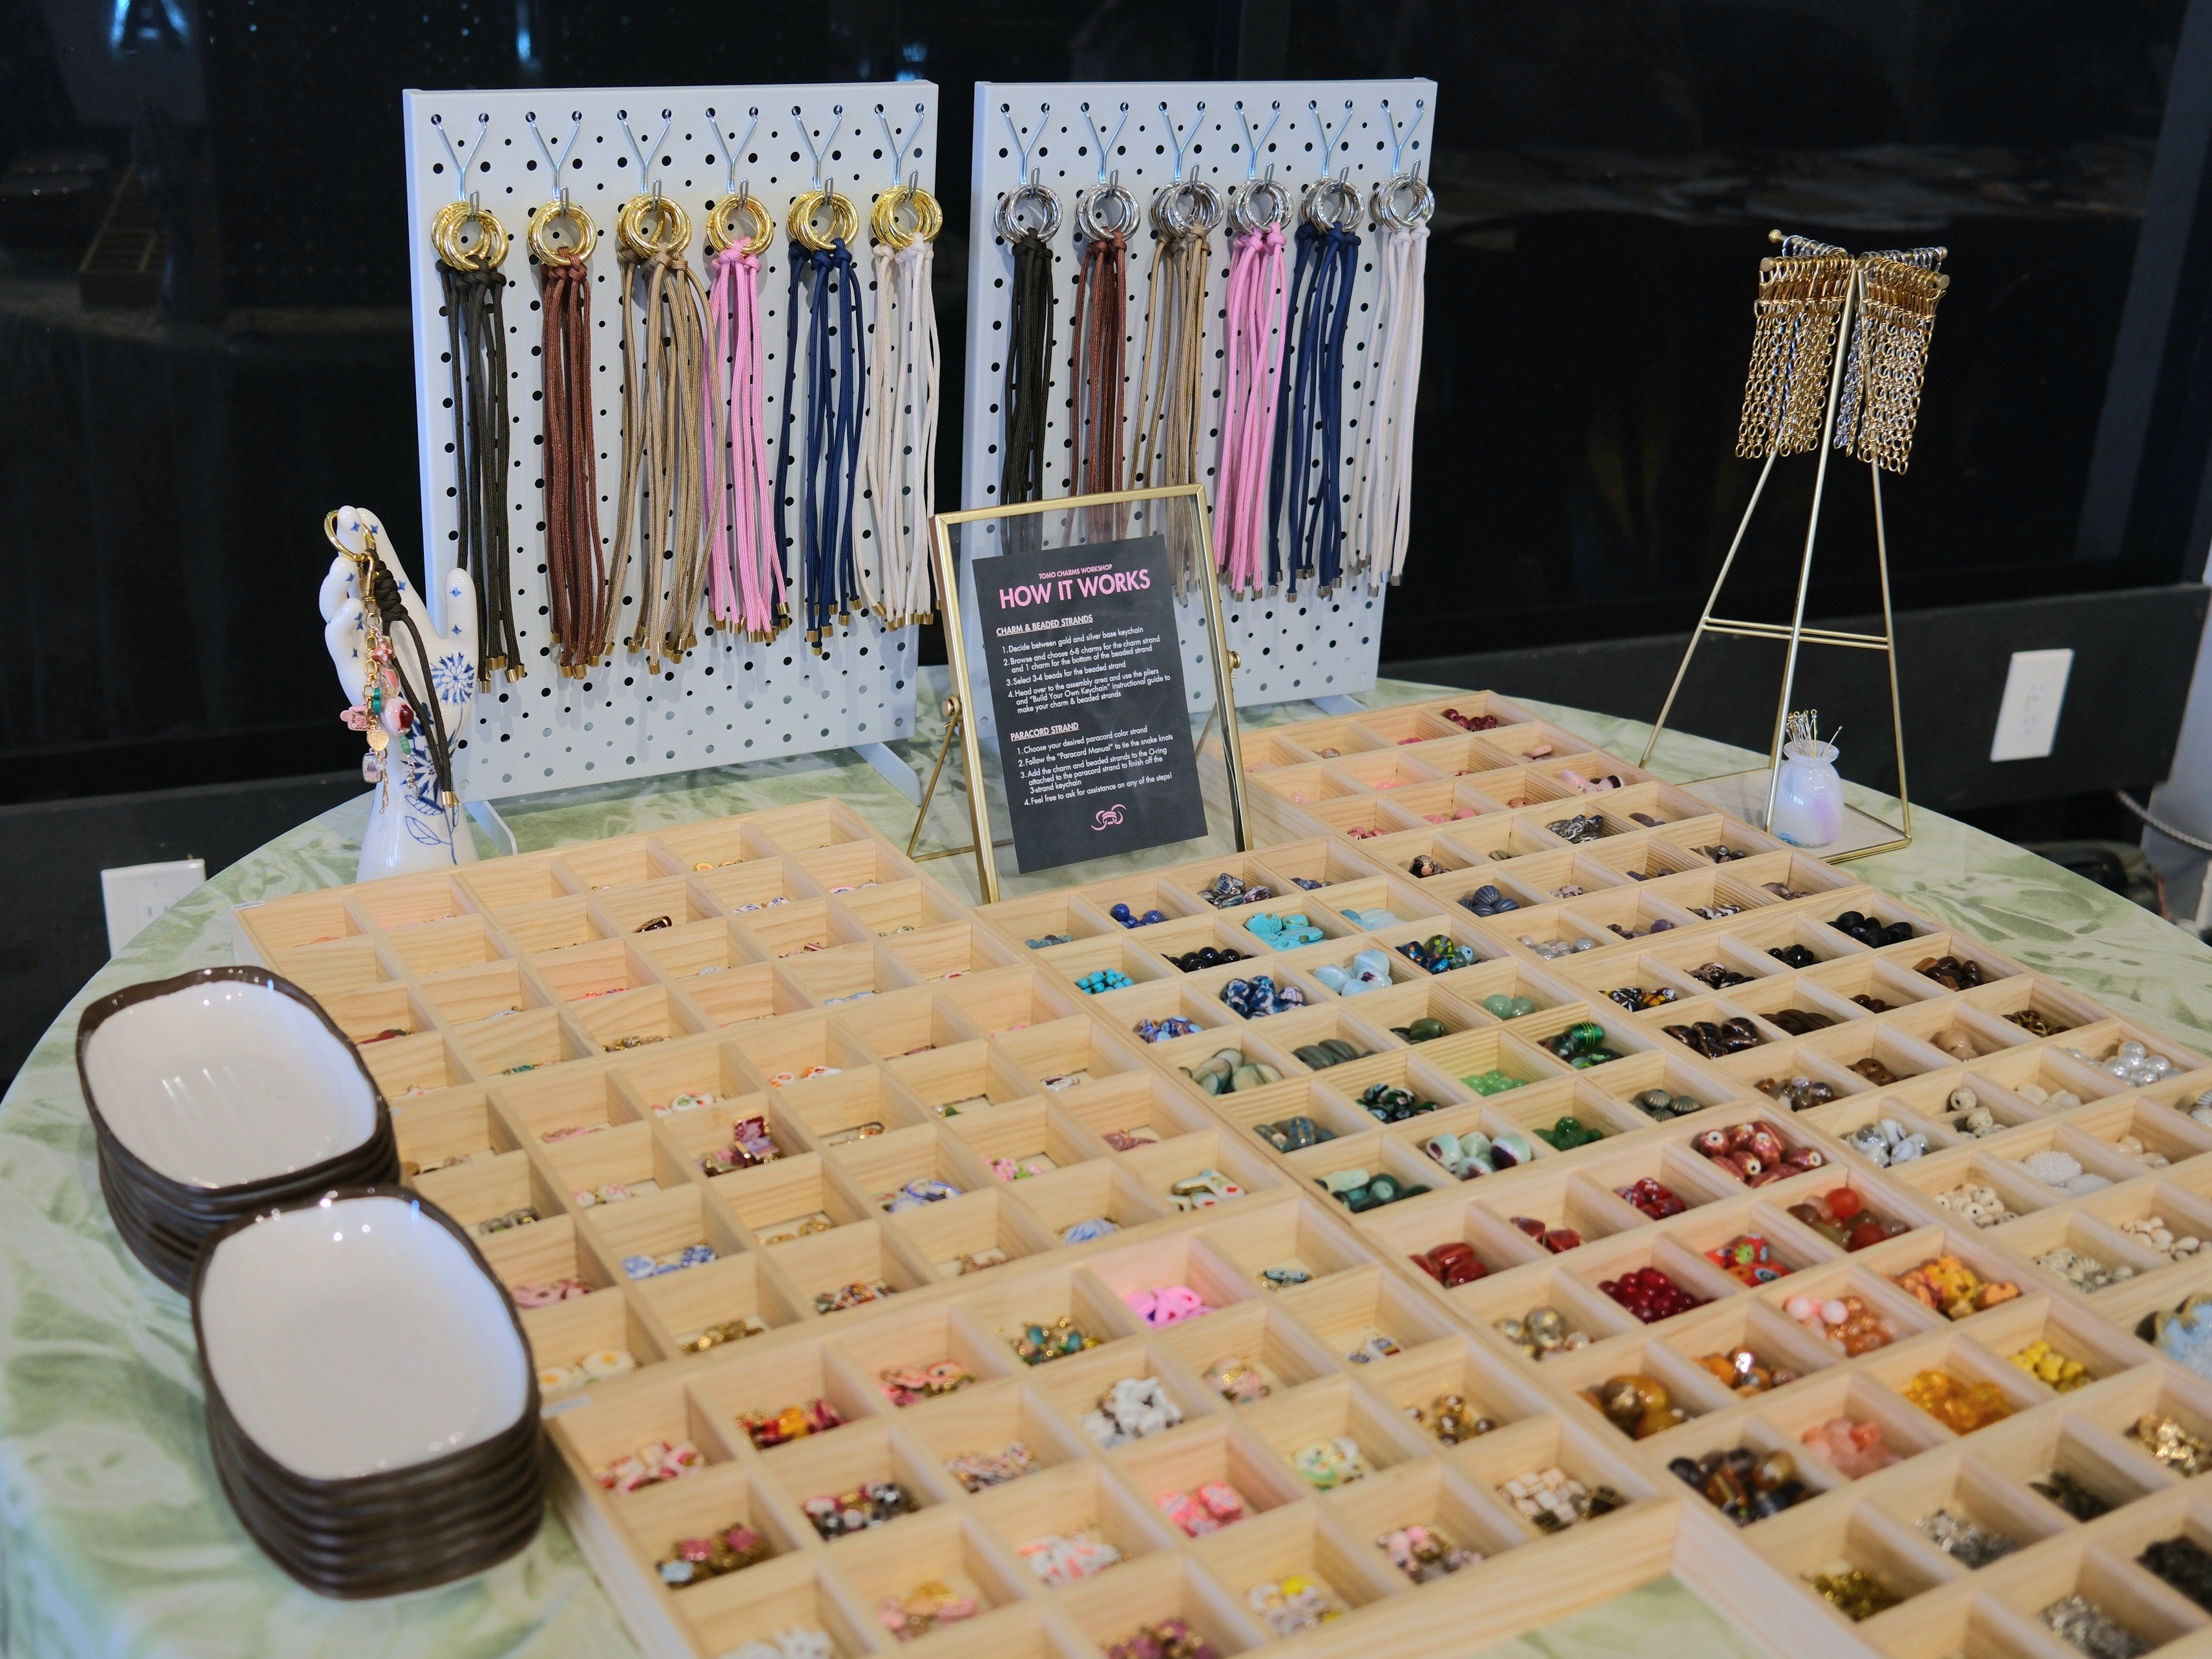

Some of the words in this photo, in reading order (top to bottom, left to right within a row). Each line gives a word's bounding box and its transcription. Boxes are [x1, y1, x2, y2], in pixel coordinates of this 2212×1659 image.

[1038, 571, 1056, 579] TOMO
[1056, 568, 1080, 577] CHARMS
[1080, 563, 1112, 574] WORKSHOP
[999, 582, 1052, 609] HOW
[1058, 579, 1073, 601] IT
[1076, 569, 1151, 598] WORKS
[996, 625, 1024, 636] CHARM
[1025, 623, 1031, 632] &
[1032, 619, 1060, 631] BEADED
[1061, 614, 1093, 627] STRANDS
[1030, 641, 1057, 649] between
[1058, 636, 1072, 647] gold
[1072, 634, 1085, 643] and
[1086, 632, 1101, 641] silver
[1117, 626, 1143, 637] keychain
[1011, 664, 1024, 673] and
[1031, 662, 1050, 670] charm
[1071, 656, 1092, 664] bottom
[1093, 652, 1100, 660] of
[1111, 647, 1134, 658] beaded
[1134, 643, 1153, 654] strand
[1034, 652, 1046, 662] and
[1047, 651, 1069, 660] choose
[1069, 647, 1080, 656] 6-8
[1081, 645, 1102, 654] charms
[1103, 642, 1112, 651] for
[1112, 641, 1122, 649] the
[1123, 639, 1142, 647] charm
[1142, 634, 1160, 644] strand
[1032, 673, 1043, 682] 3-4
[1043, 670, 1063, 680] beads
[1073, 667, 1083, 676] the
[1083, 663, 1107, 674] beaded
[1108, 660, 1126, 670] strand
[1065, 678, 1093, 692] assembly
[1109, 673, 1121, 682] and
[1143, 668, 1160, 678] pliers
[1016, 696, 1028, 705] and
[1112, 676, 1146, 690] instructional
[1147, 674, 1163, 686] guide
[1017, 705, 1034, 714] make
[1034, 704, 1049, 713] your
[1050, 700, 1069, 708] charm
[1076, 693, 1100, 704] beaded
[1101, 689, 1122, 700] strands
[1010, 727, 1050, 741] PARACORD
[1050, 722, 1079, 734] STRAND
[1047, 742, 1061, 752] your
[1063, 736, 1085, 747] desired
[1085, 731, 1113, 745] paracord
[1114, 729, 1129, 738] color
[1130, 724, 1148, 735] strand
[1041, 767, 1052, 775] the
[1052, 765, 1072, 773] charm
[1072, 760, 1085, 769] and
[1085, 755, 1109, 767] beaded
[1110, 752, 1131, 763] strands
[1148, 747, 1167, 758] O-ring
[1046, 754, 1056, 762] the
[1140, 736, 1158, 746] snake
[1028, 774, 1055, 786] attached
[1063, 771, 1073, 780] the
[1074, 765, 1101, 780] paracord
[1102, 762, 1120, 773] strand
[1128, 758, 1143, 767] finish
[1145, 756, 1153, 764] off
[1153, 755, 1163, 763] the
[1030, 782, 1054, 794] 3-strand
[1054, 778, 1082, 790] keychain
[1065, 789, 1076, 798] ask
[1076, 788, 1085, 797] for
[1087, 784, 1116, 795] assistance
[1138, 776, 1145, 785] of
[1156, 771, 1172, 782] steps!
